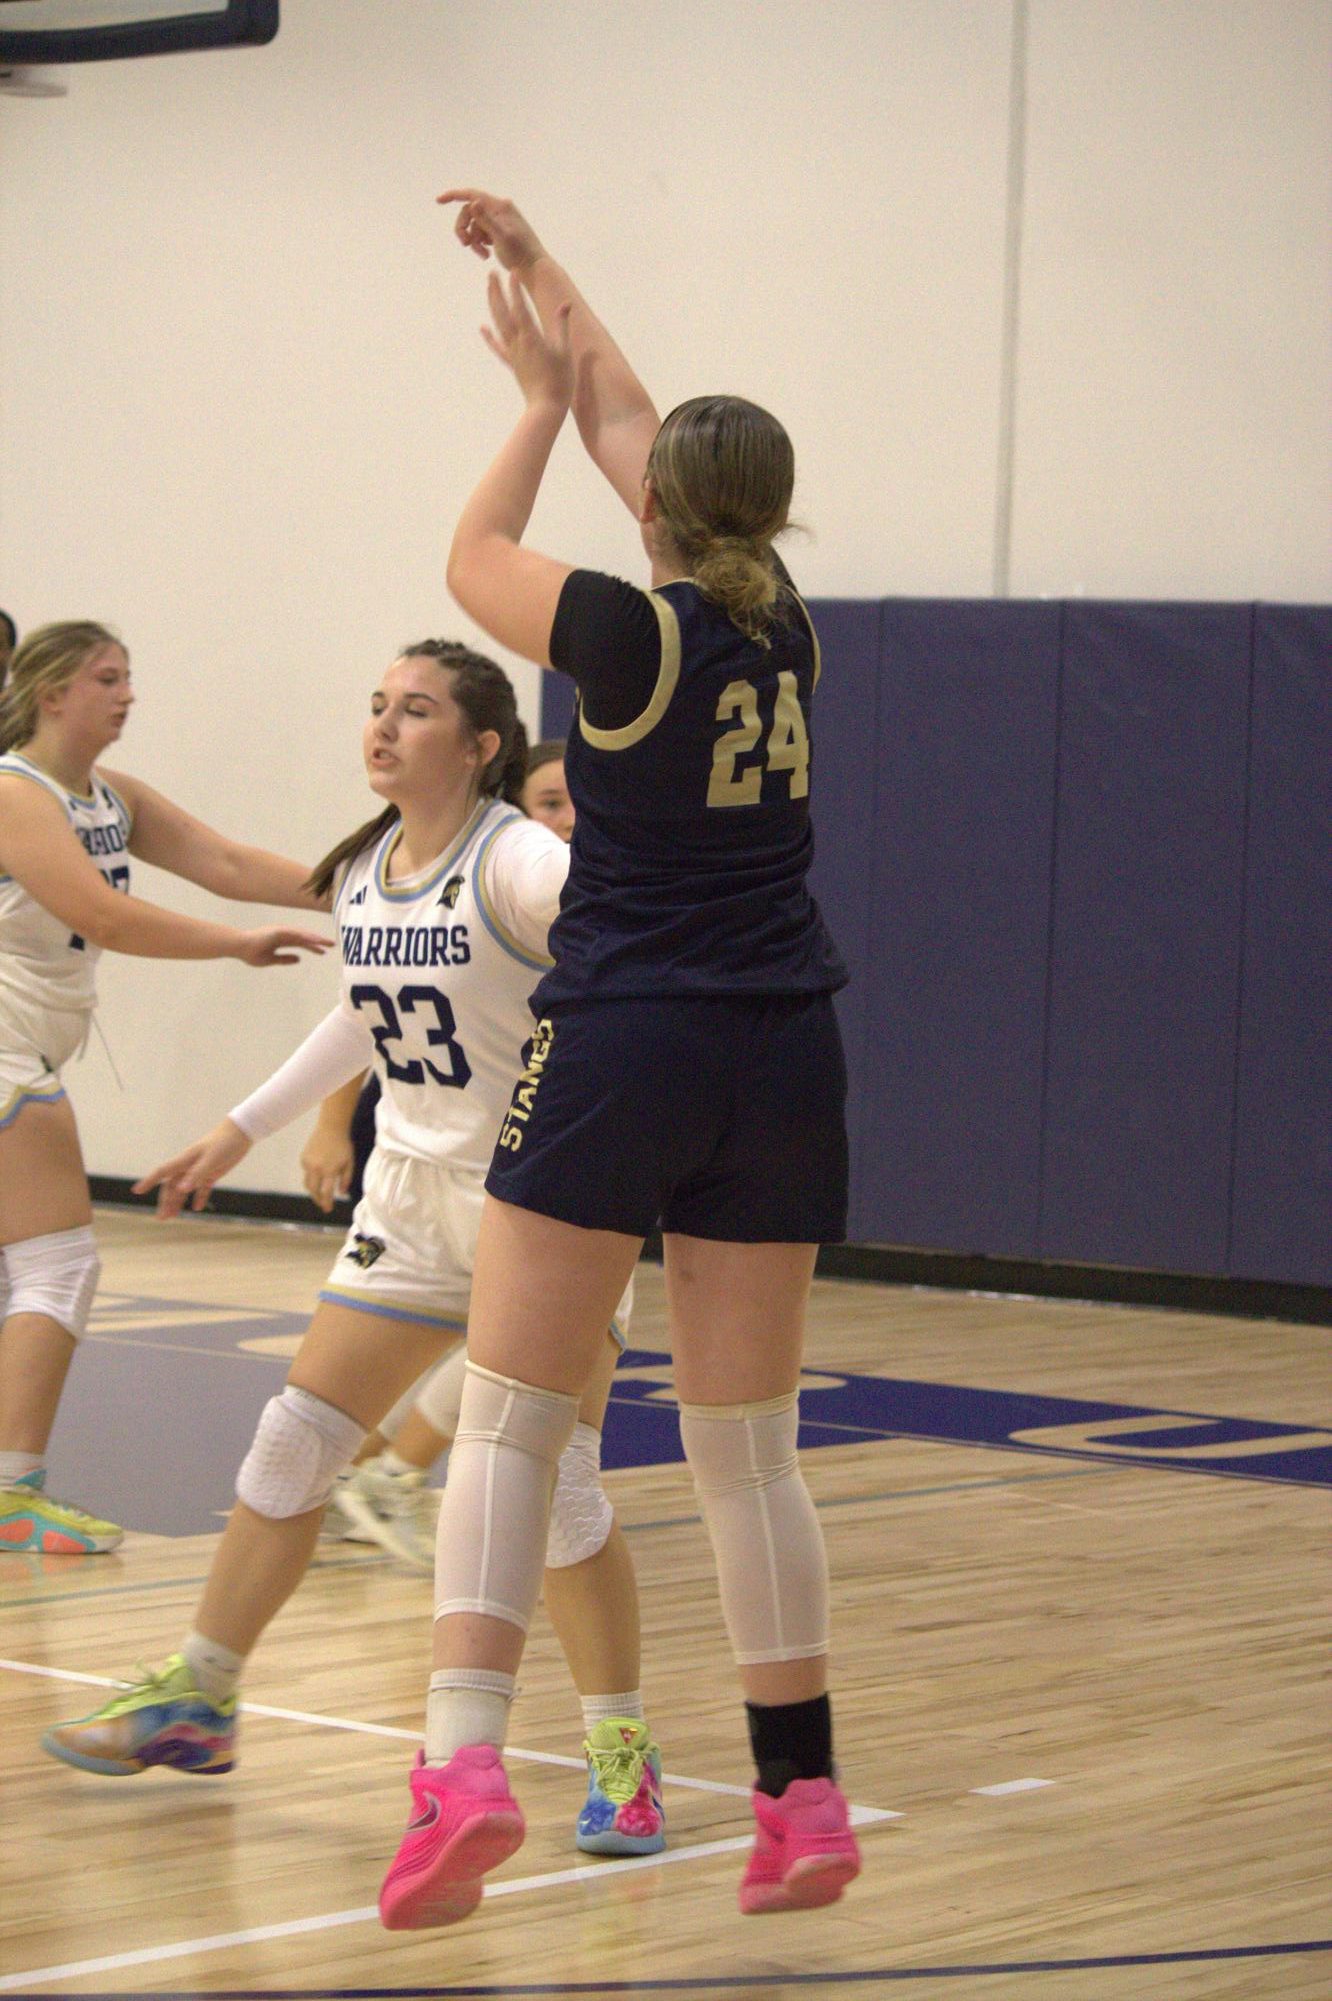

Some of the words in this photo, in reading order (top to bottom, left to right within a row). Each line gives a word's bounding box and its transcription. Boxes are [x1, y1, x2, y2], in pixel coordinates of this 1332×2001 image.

[707, 670, 809, 807] 24
[341, 925, 470, 966] WARRIORS
[350, 985, 471, 1089] 23
